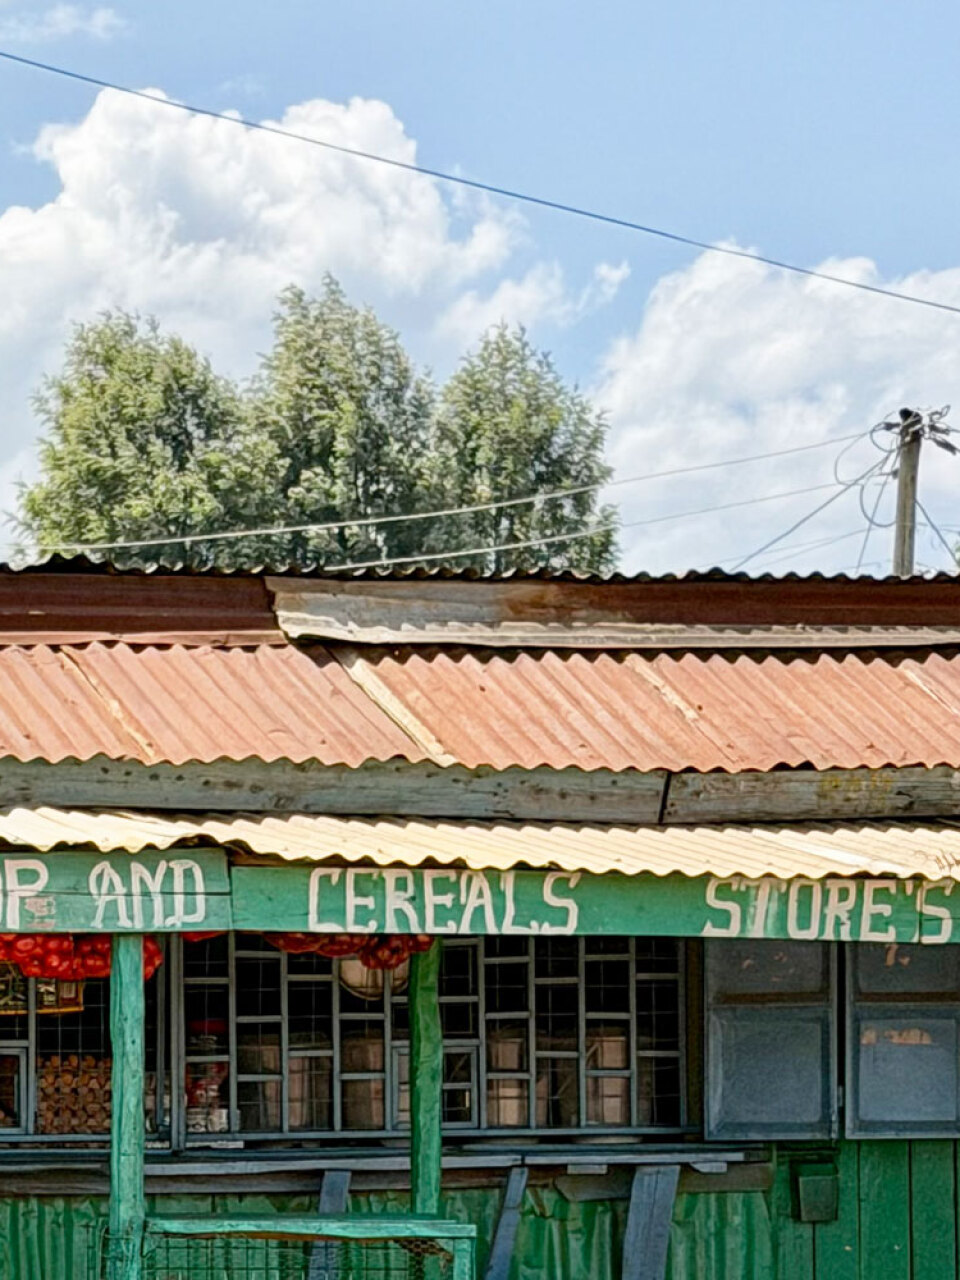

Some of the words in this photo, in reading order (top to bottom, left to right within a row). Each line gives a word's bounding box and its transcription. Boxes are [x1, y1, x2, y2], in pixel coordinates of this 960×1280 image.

[89, 860, 206, 929] AND
[308, 867, 581, 934] CEREALS
[701, 877, 954, 944] STORE'S
